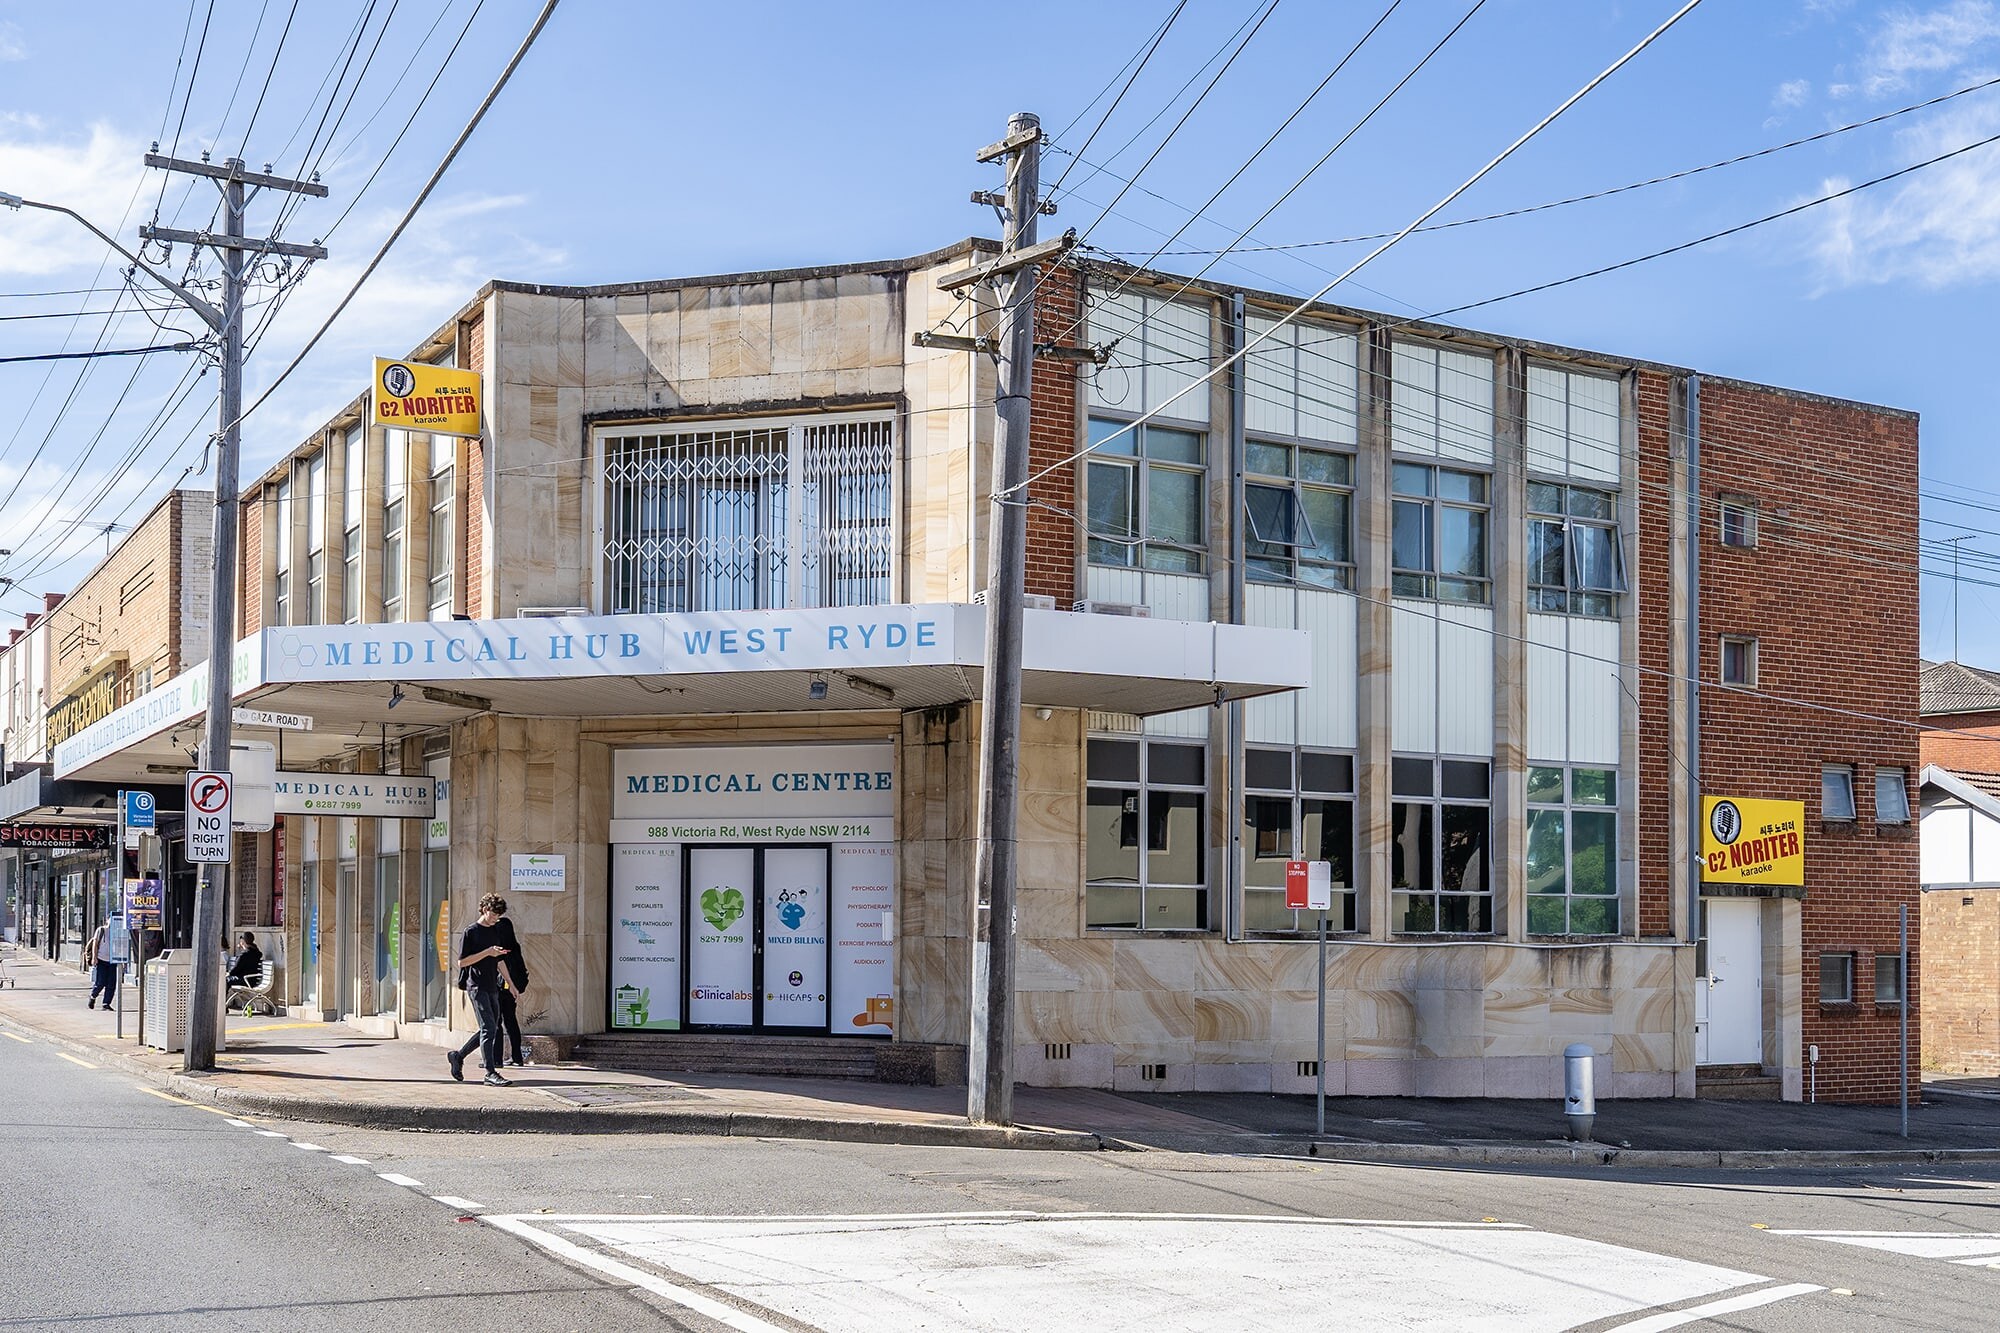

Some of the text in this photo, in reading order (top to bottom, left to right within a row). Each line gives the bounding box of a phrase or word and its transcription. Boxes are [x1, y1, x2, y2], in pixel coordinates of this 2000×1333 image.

[380, 396, 476, 417] C2 NORITER
[414, 416, 447, 424] karaoke
[326, 622, 936, 666] MEDICAL HUB WEST RYDE
[47, 675, 114, 750] EPOXY FLOORING
[251, 712, 298, 726] GAZA ROAD
[61, 738, 85, 768] MEDICAL
[92, 723, 114, 752] ALLIED
[116, 706, 146, 740] HEALTH
[148, 687, 181, 726] CENTRE
[626, 772, 892, 793] MEDICAL CENTRE
[275, 782, 428, 798] MEDICAL HUB
[141, 797, 148, 807] B
[198, 817, 220, 830] NO
[431, 822, 447, 838] OPEN
[0, 827, 96, 841] SMOKEEY
[193, 834, 224, 844] RIGHT
[648, 825, 870, 839] 988 Victoria Rd, West Ryde NSW 2114
[194, 847, 223, 856] TURN
[1708, 832, 1799, 872] C2 NORITER
[1740, 864, 1772, 877] karaoke
[132, 896, 159, 905] TRUTH
[696, 990, 752, 1000] Clinicalabs
